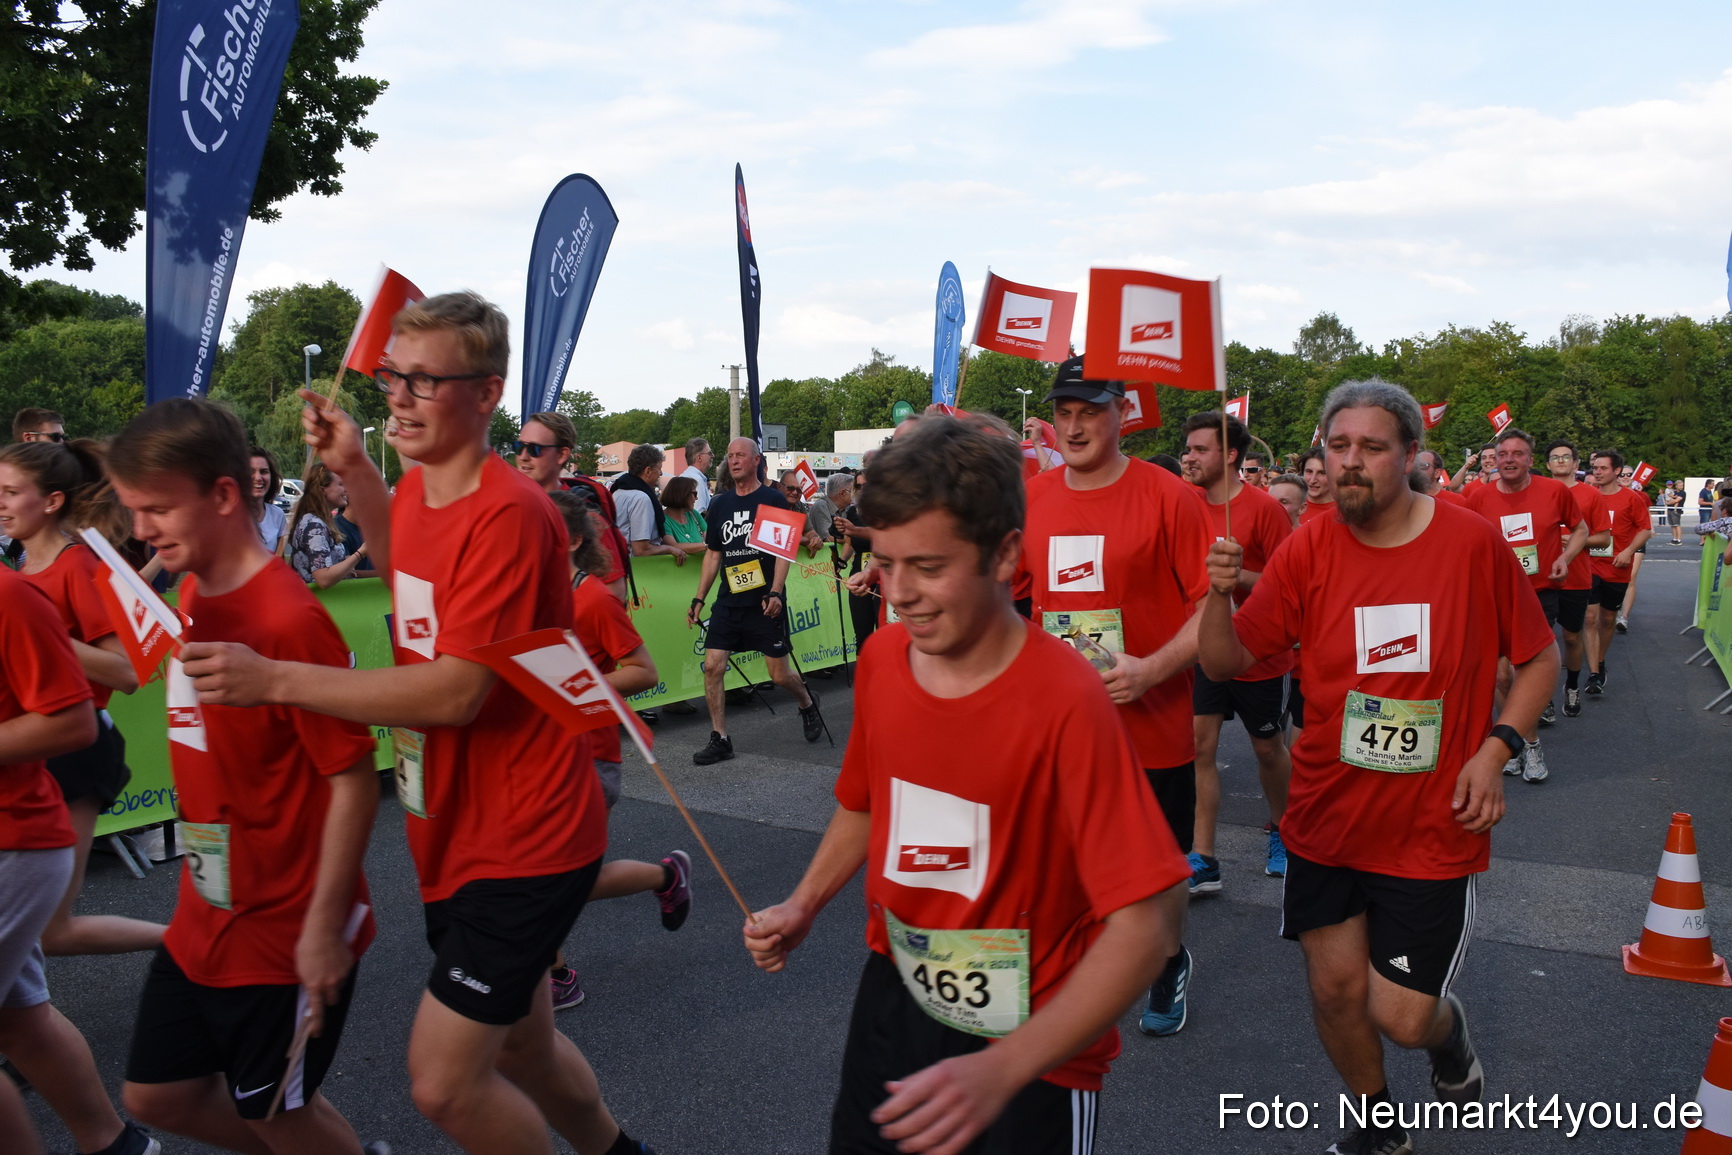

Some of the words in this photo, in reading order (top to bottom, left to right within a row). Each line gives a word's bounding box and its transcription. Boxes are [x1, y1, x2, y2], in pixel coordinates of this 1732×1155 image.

[200, 0, 256, 123] Fisch
[559, 206, 590, 284] Fischer
[570, 221, 595, 284] AUTOMOBILE
[186, 227, 234, 400] her-automobile.de
[734, 571, 755, 586] 387
[1379, 642, 1403, 657] DEHN
[1360, 722, 1419, 753] 479
[1356, 747, 1367, 756] Dr.
[1368, 750, 1397, 761] Hannig
[1398, 753, 1422, 761] Martin
[1364, 756, 1380, 764] DEHN
[912, 853, 950, 866] DEHN
[913, 963, 991, 1009] 463
